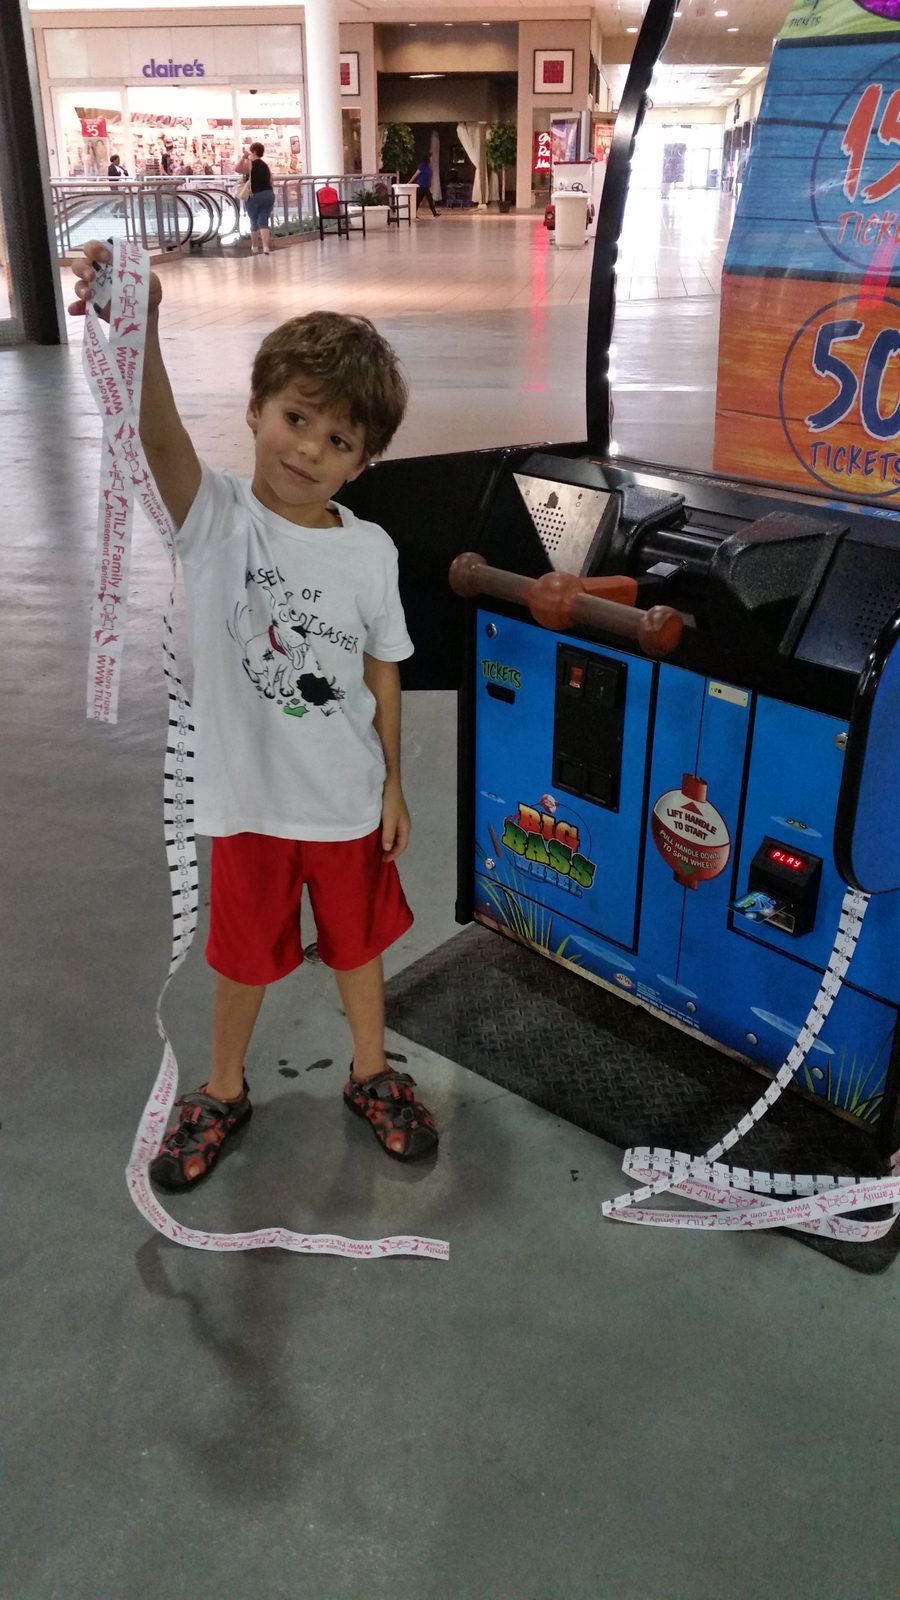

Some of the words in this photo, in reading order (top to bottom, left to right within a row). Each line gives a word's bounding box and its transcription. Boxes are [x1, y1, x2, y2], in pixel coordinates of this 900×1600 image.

[142, 58, 205, 78] claire's
[804, 320, 900, 440] 50
[113, 510, 127, 540] TILT
[107, 545, 125, 588] Family
[302, 588, 322, 603] OF
[298, 612, 359, 654] DISASTER
[481, 659, 521, 689] TICKETS
[518, 802, 580, 853] BIG
[667, 808, 683, 819] LIFT
[685, 813, 718, 835] HANDLE
[674, 821, 684, 830] TO
[685, 824, 708, 840] START
[501, 816, 597, 890] BASS
[660, 830, 674, 845] PULL
[675, 842, 699, 858] HANDLE
[664, 842, 672, 853] TO
[673, 850, 689, 863] SPIN
[773, 851, 801, 868] PLAY
